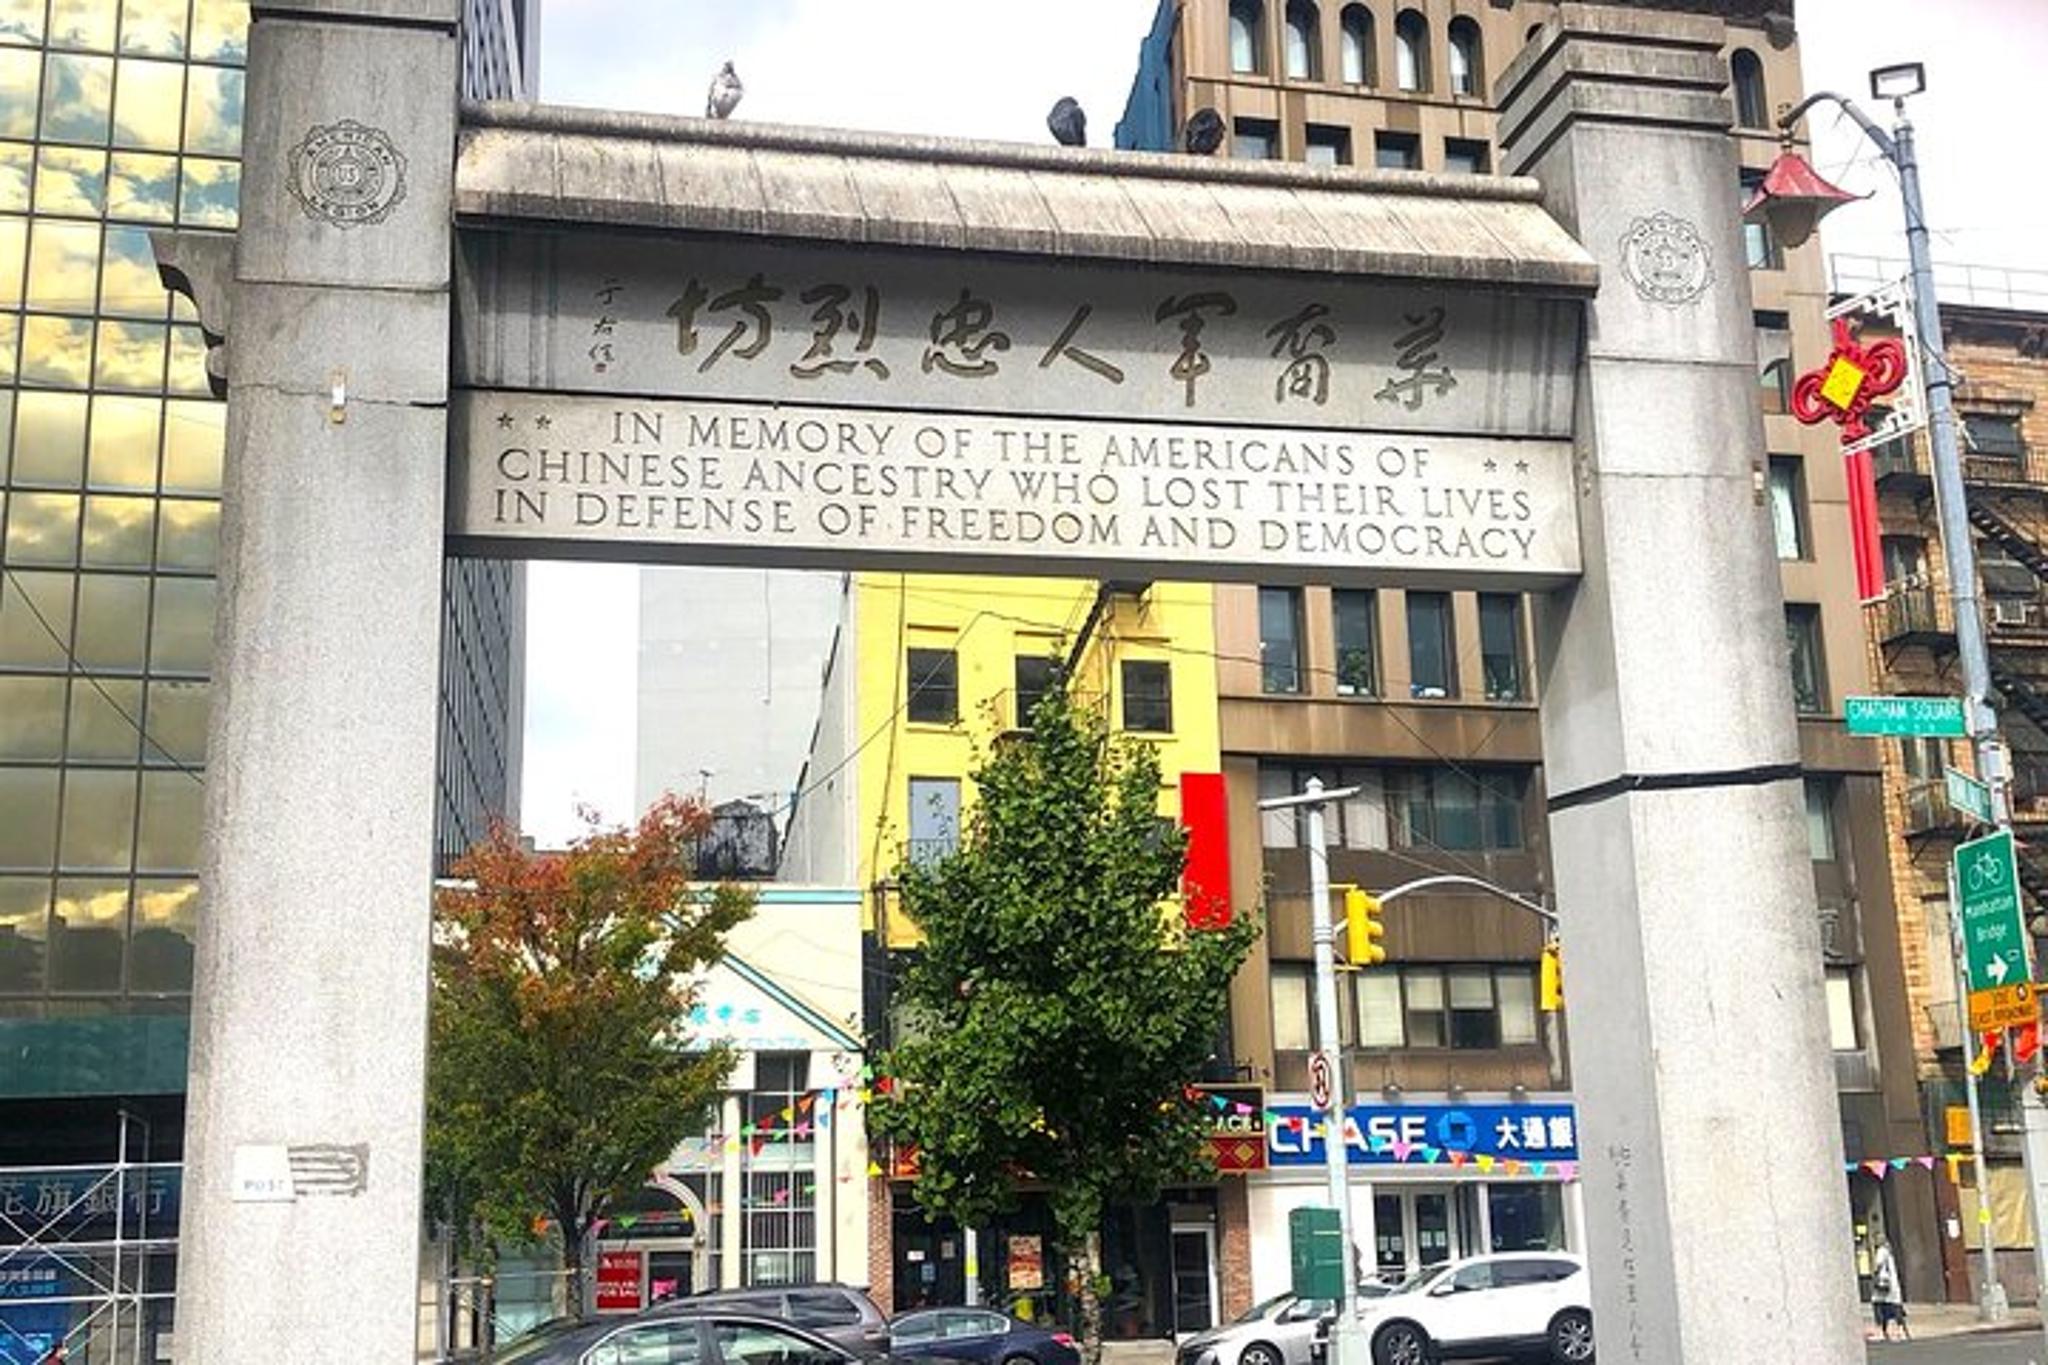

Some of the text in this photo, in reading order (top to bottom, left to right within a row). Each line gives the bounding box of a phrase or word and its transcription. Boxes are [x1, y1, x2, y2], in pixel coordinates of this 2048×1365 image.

[612, 411, 1429, 478] IN MEMORY OF THE AMERICANS OF
[497, 448, 1532, 521] CHINESE ANCESTRY WHO LOST THEIR LIVES
[495, 488, 1537, 560] IN DEFENSE OF FREEDOM AND DEMOCRACY
[1849, 701, 1960, 719] CHATHAM SQUARE
[1966, 895, 2014, 918] Manhattan
[1976, 923, 2007, 942] Bridge
[1271, 1116, 1429, 1152] CHASE
